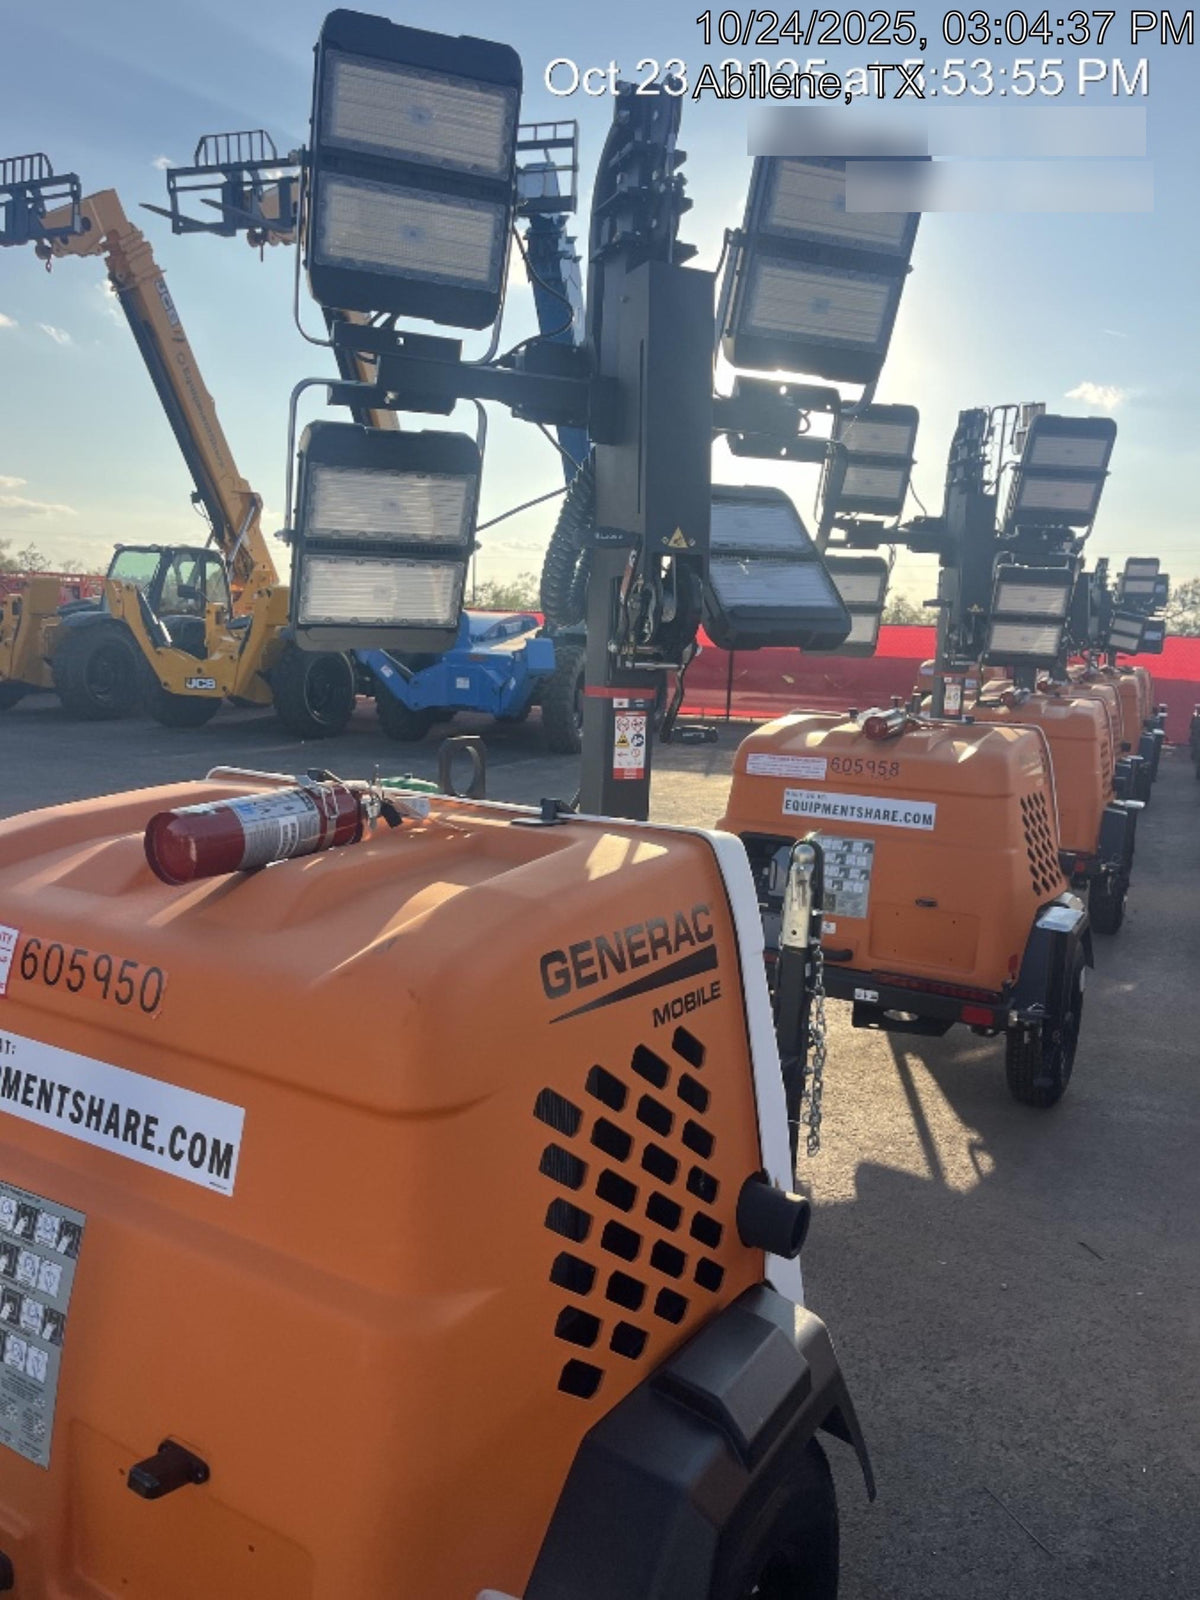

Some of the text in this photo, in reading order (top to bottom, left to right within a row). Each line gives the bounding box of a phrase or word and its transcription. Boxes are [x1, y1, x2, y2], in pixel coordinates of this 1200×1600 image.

[186, 678, 216, 689] JCB
[785, 800, 933, 825] EQUIPMENTSHARE.COM
[20, 938, 164, 1013] 605950
[540, 903, 714, 999] GENERAC
[652, 980, 721, 1028] MOBILE
[0, 1066, 234, 1179] MENTSHARE.COM
